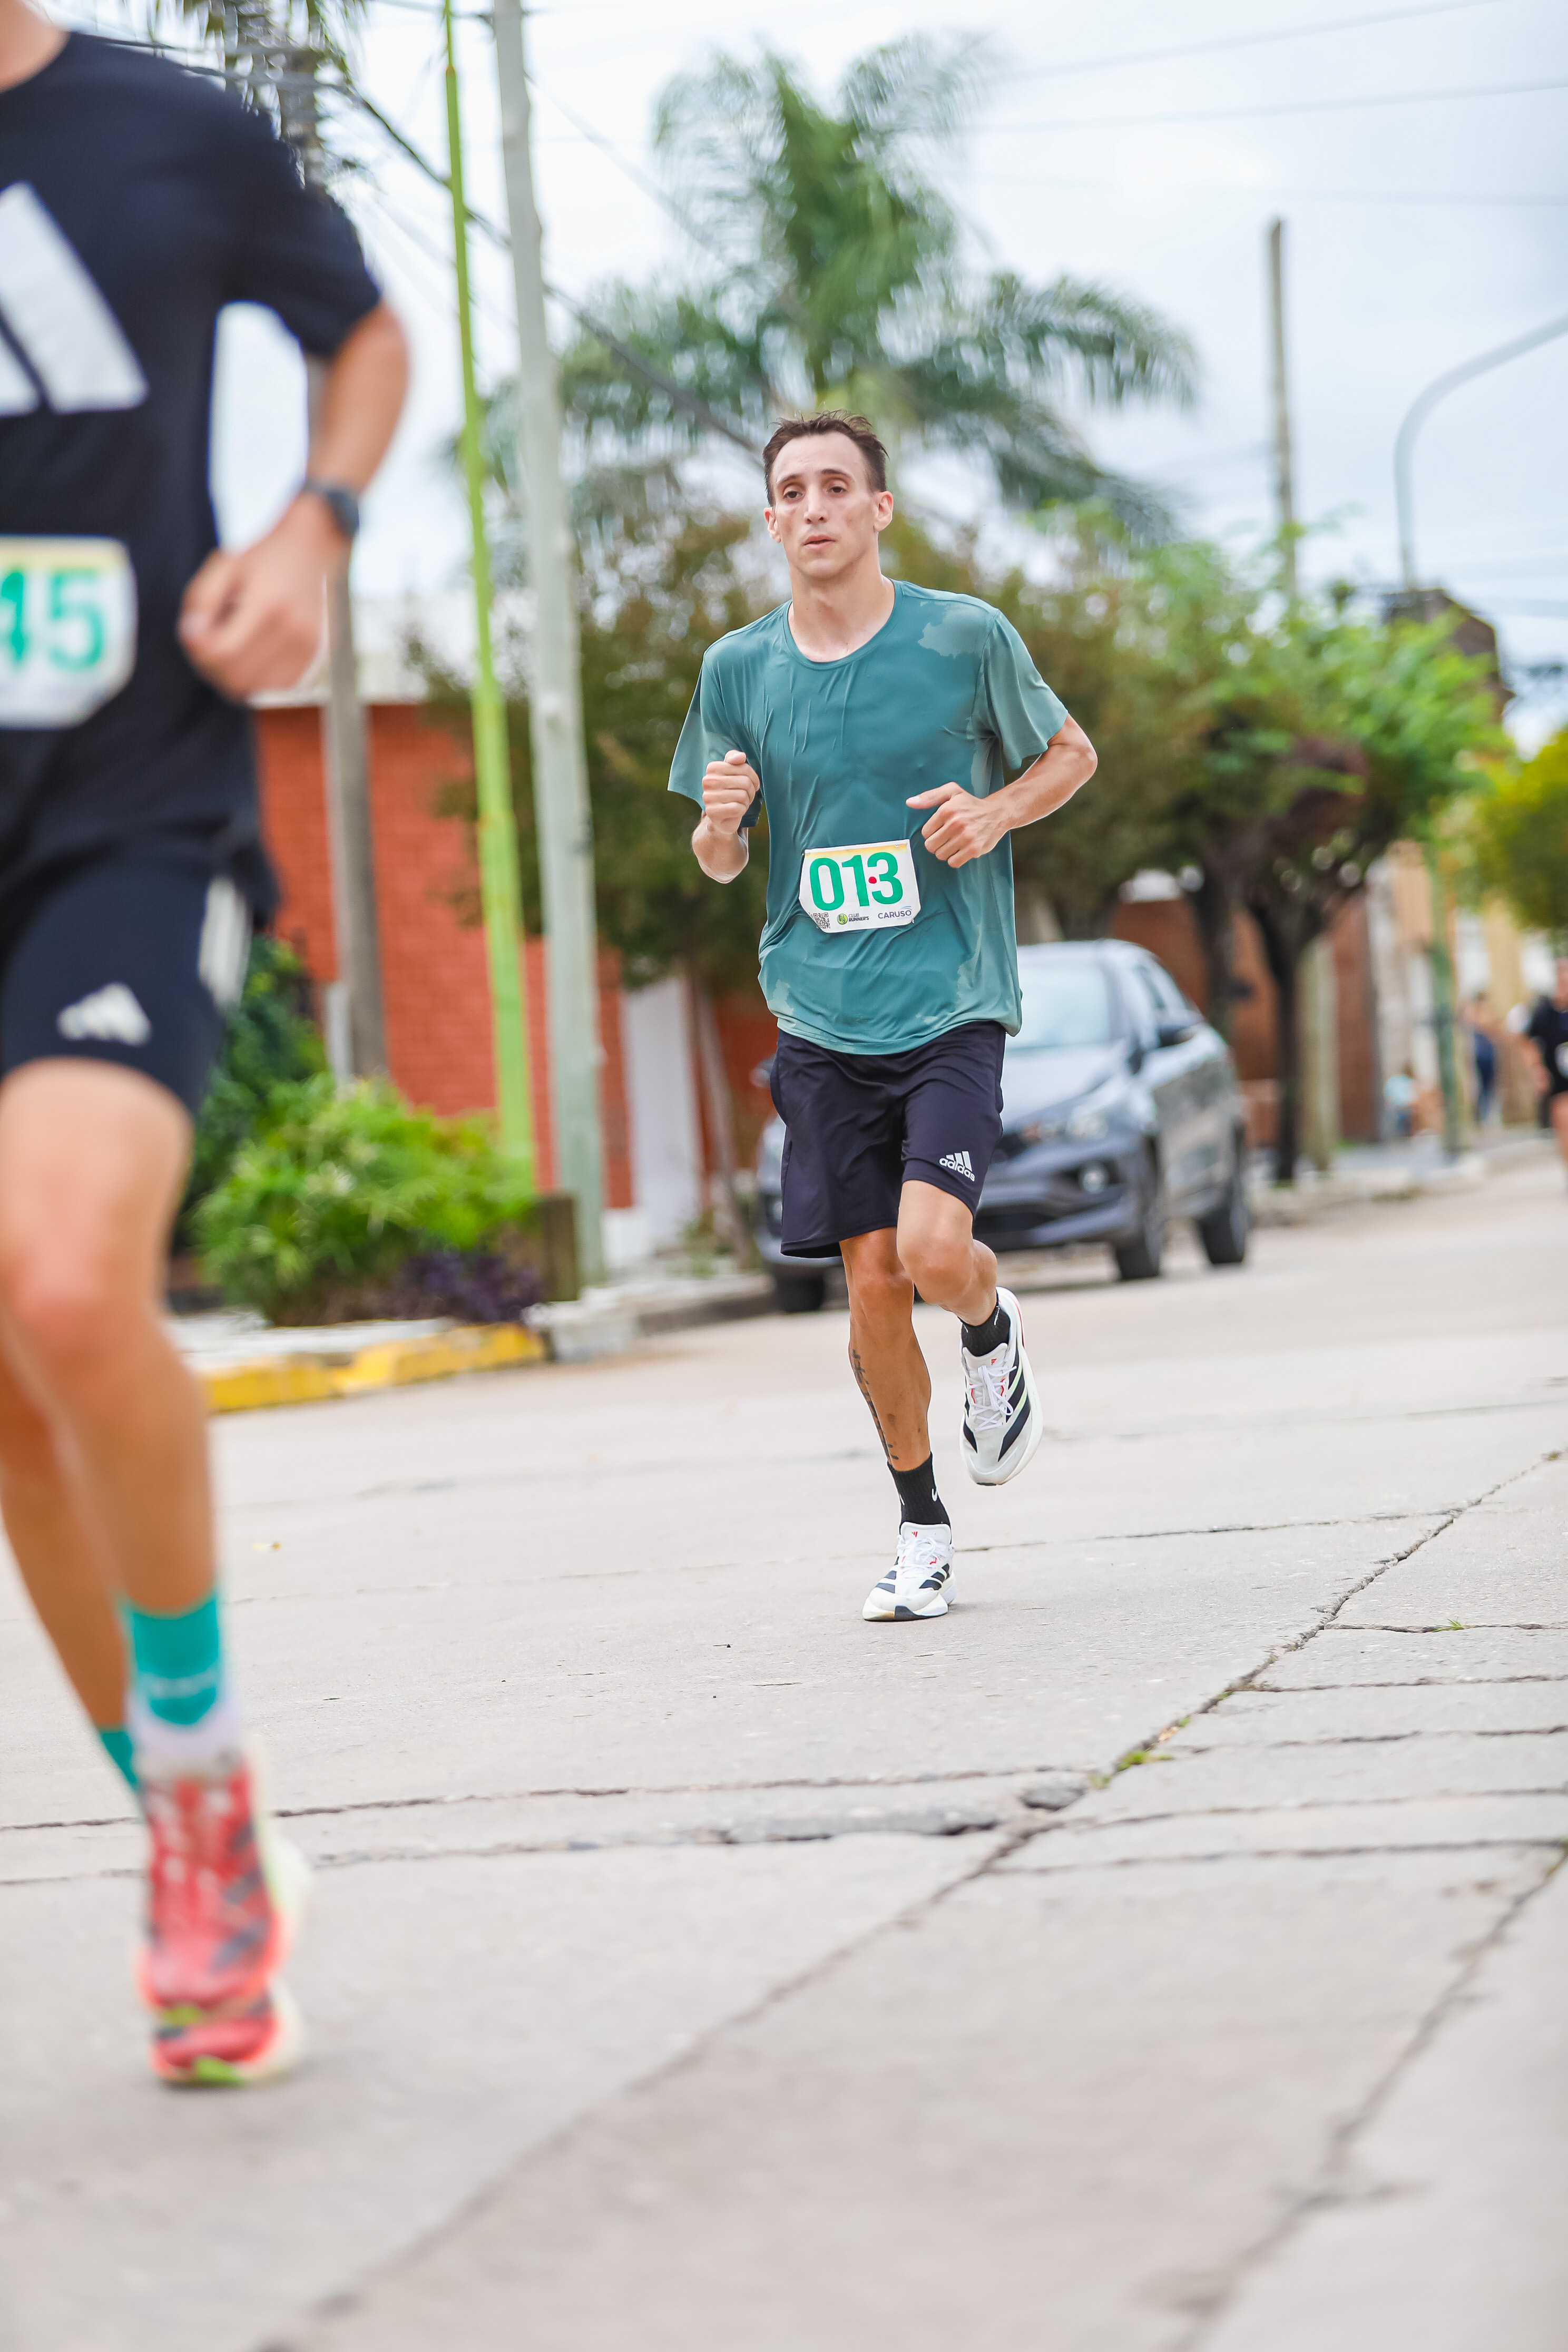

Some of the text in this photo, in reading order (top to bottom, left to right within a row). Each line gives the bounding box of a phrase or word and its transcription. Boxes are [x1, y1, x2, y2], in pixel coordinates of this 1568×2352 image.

[809, 852, 903, 910] 013
[878, 910, 912, 919] CARUSO
[939, 1158, 975, 1182] adidas
